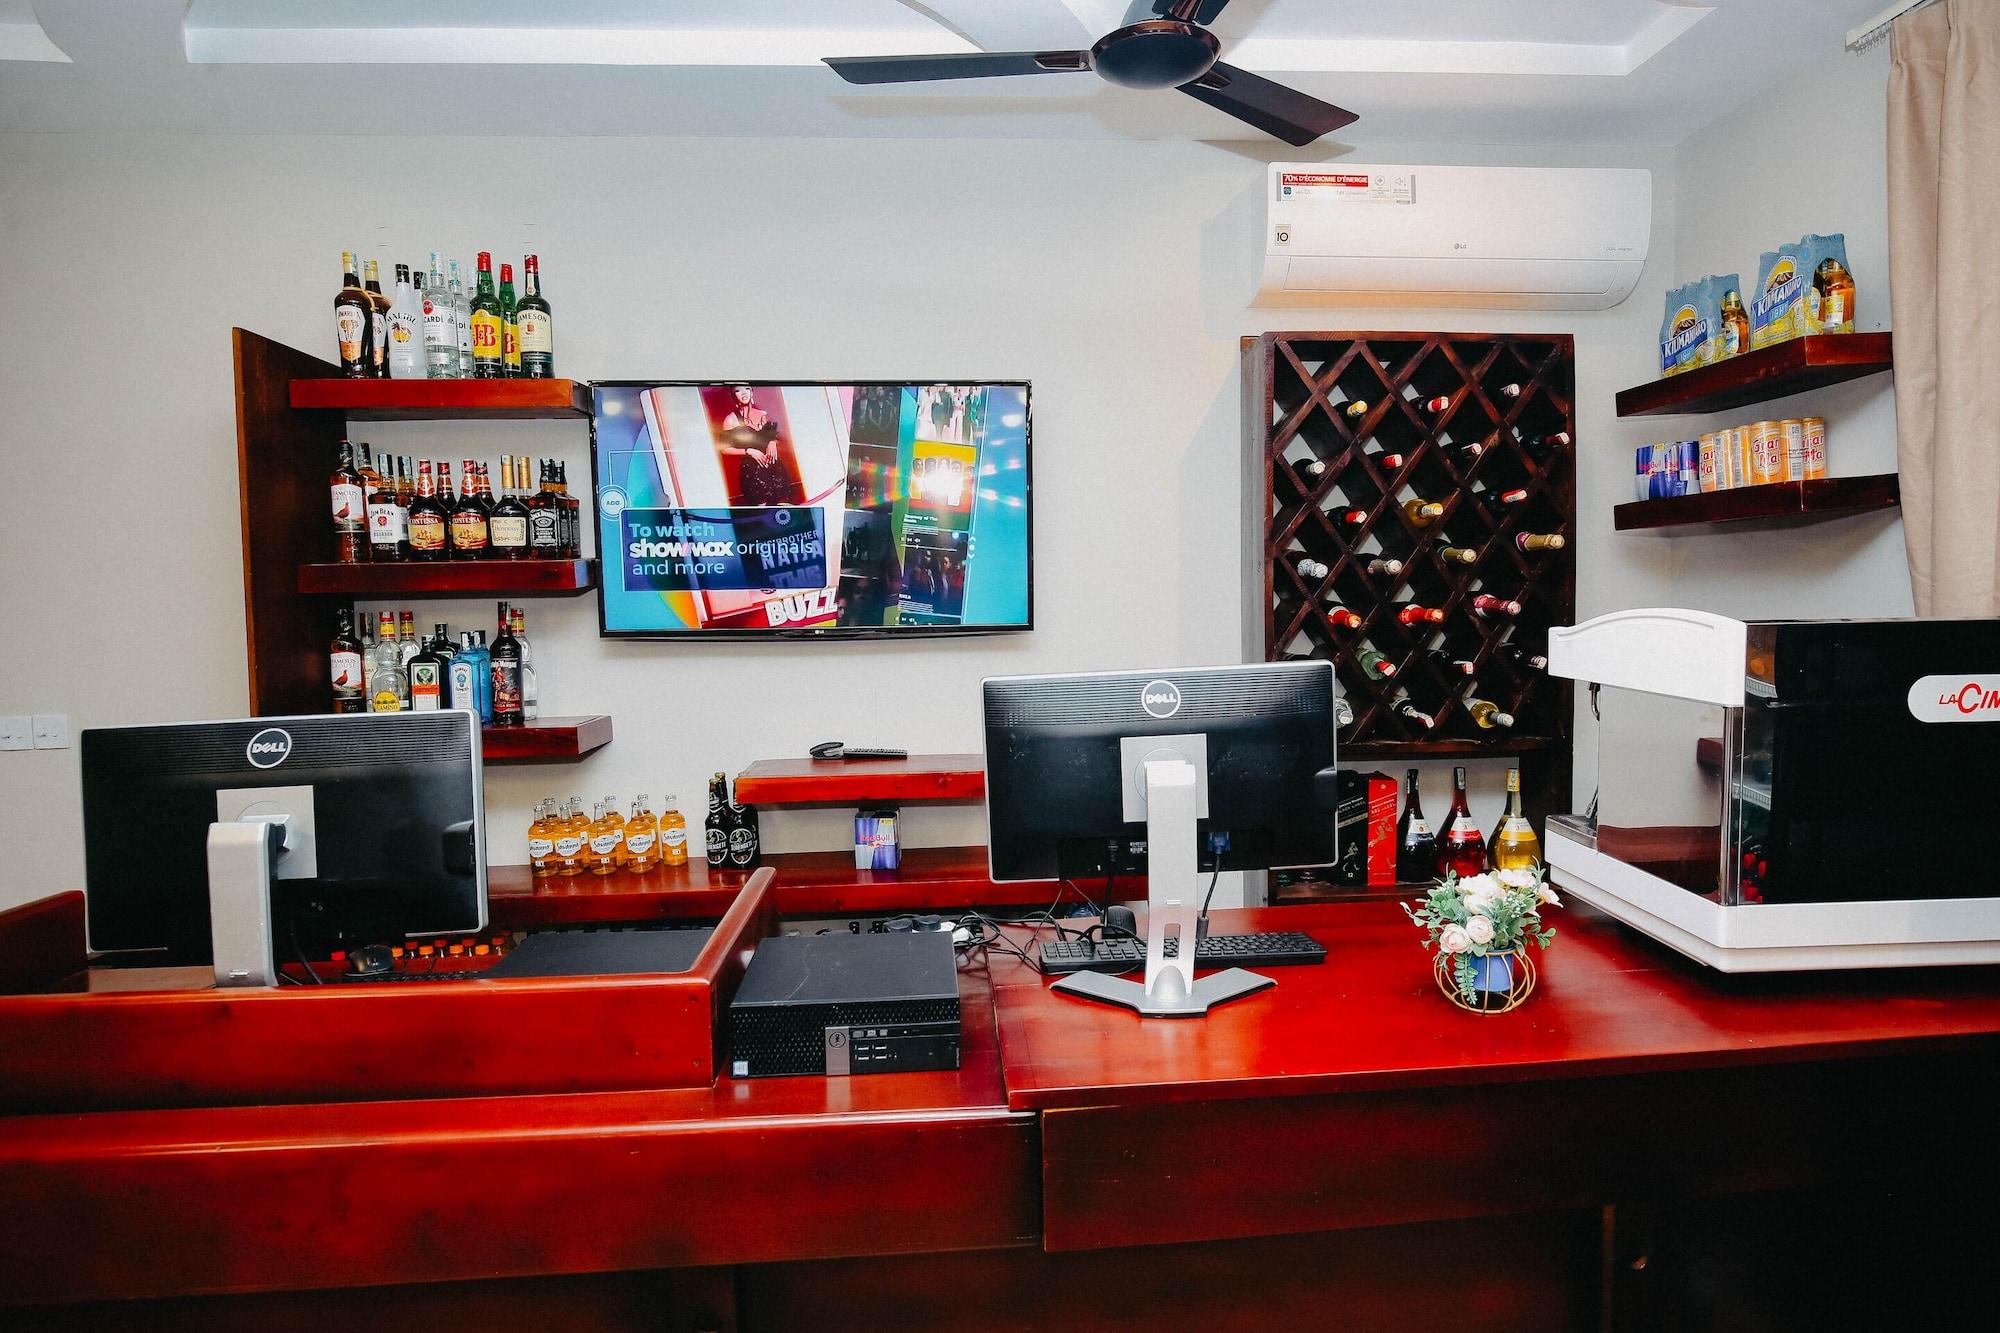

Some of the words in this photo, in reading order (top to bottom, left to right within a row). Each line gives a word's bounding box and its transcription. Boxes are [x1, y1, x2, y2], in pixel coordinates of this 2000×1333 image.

[1283, 174, 1299, 182] 70%
[1299, 174, 1336, 183] D'ÉCONOMIE
[1336, 175, 1368, 184] D'ÉNERGIE
[1277, 232, 1289, 242] 10
[409, 517, 439, 526] CONTESSA
[452, 517, 481, 525] CONTESSA
[628, 522, 652, 538] To
[654, 521, 716, 538] watch
[736, 538, 813, 558] originals
[632, 559, 669, 576] and
[674, 562, 725, 576] more
[764, 586, 838, 627] BUZZ
[1145, 693, 1177, 704] DELL
[251, 742, 286, 754] DELL
[662, 830, 686, 840] Savanna
[557, 841, 580, 851] Savanna
[628, 837, 652, 848] Savanna
